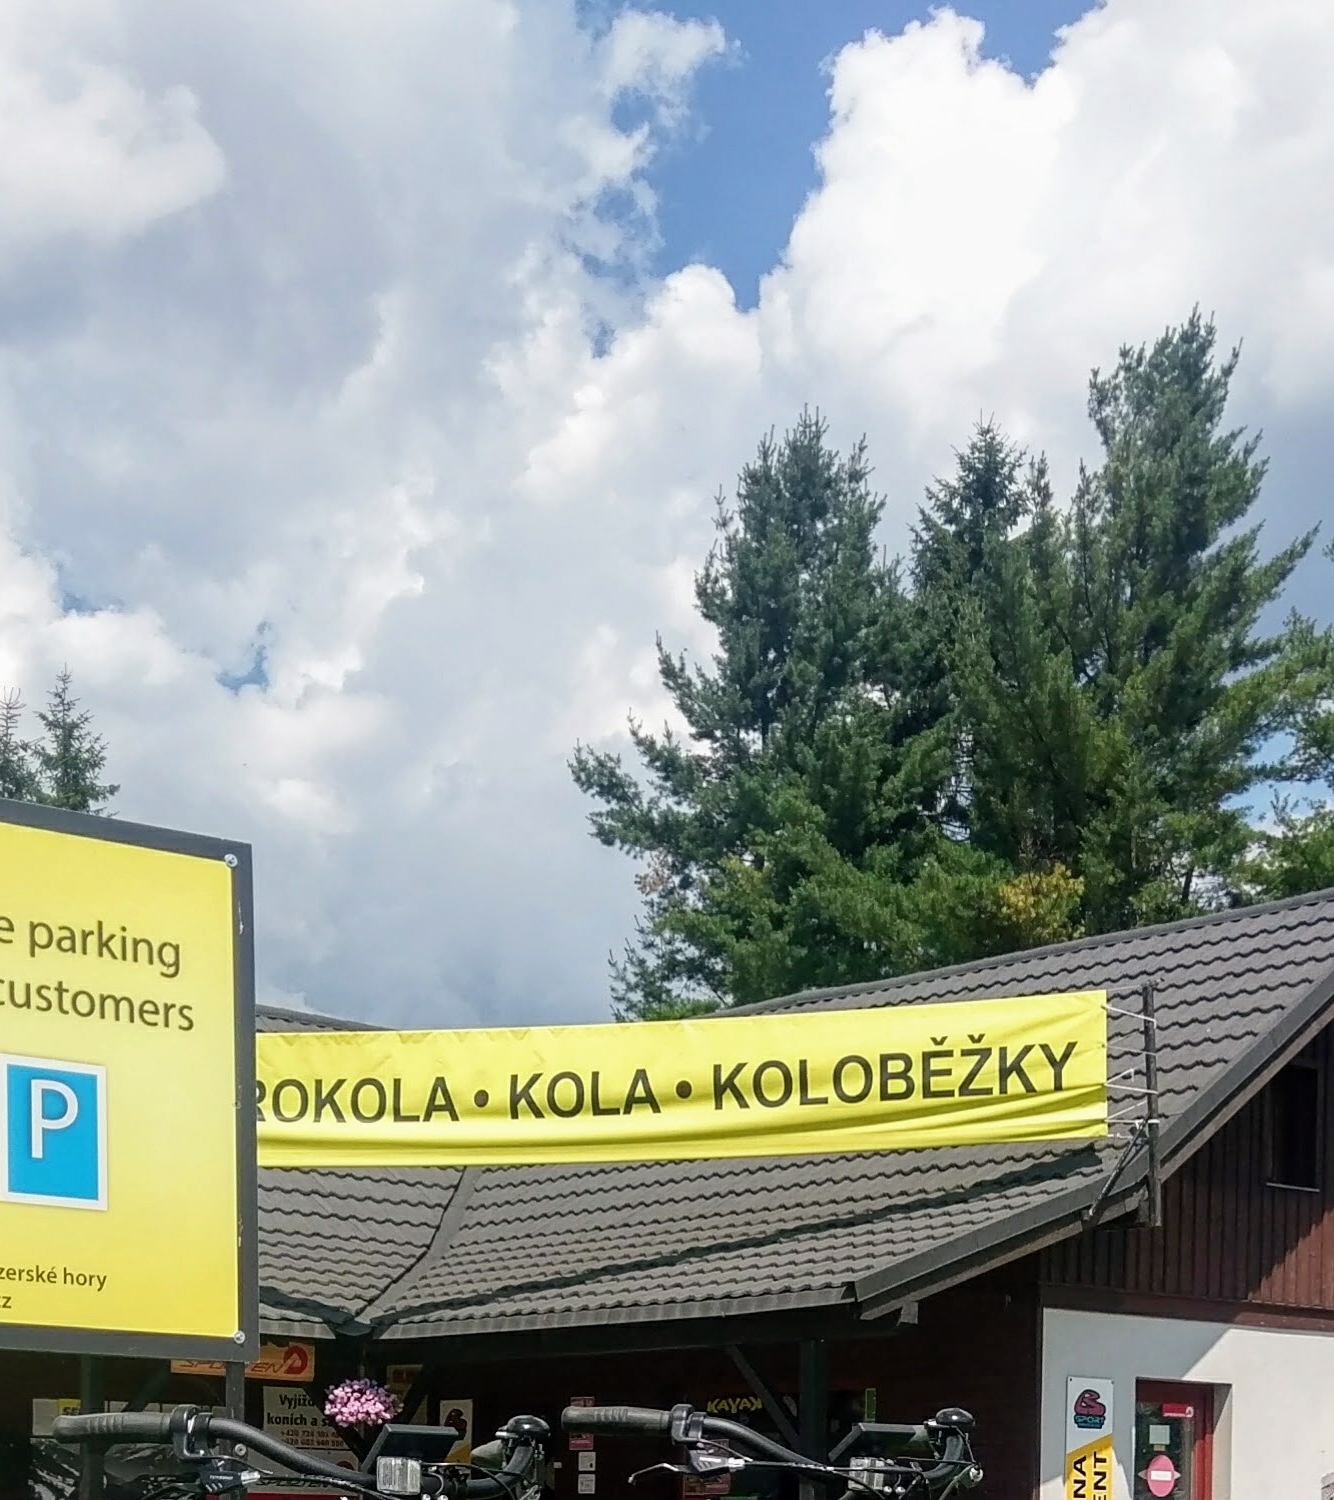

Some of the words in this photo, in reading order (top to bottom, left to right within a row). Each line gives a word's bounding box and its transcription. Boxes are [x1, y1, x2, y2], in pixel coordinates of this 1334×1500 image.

[28, 920, 181, 978] parking
[509, 1068, 661, 1120] KOLA
[713, 1033, 1078, 1111] KOLOBĚŽKY
[30, 1078, 79, 1159] P
[63, 1266, 108, 1292] hory
